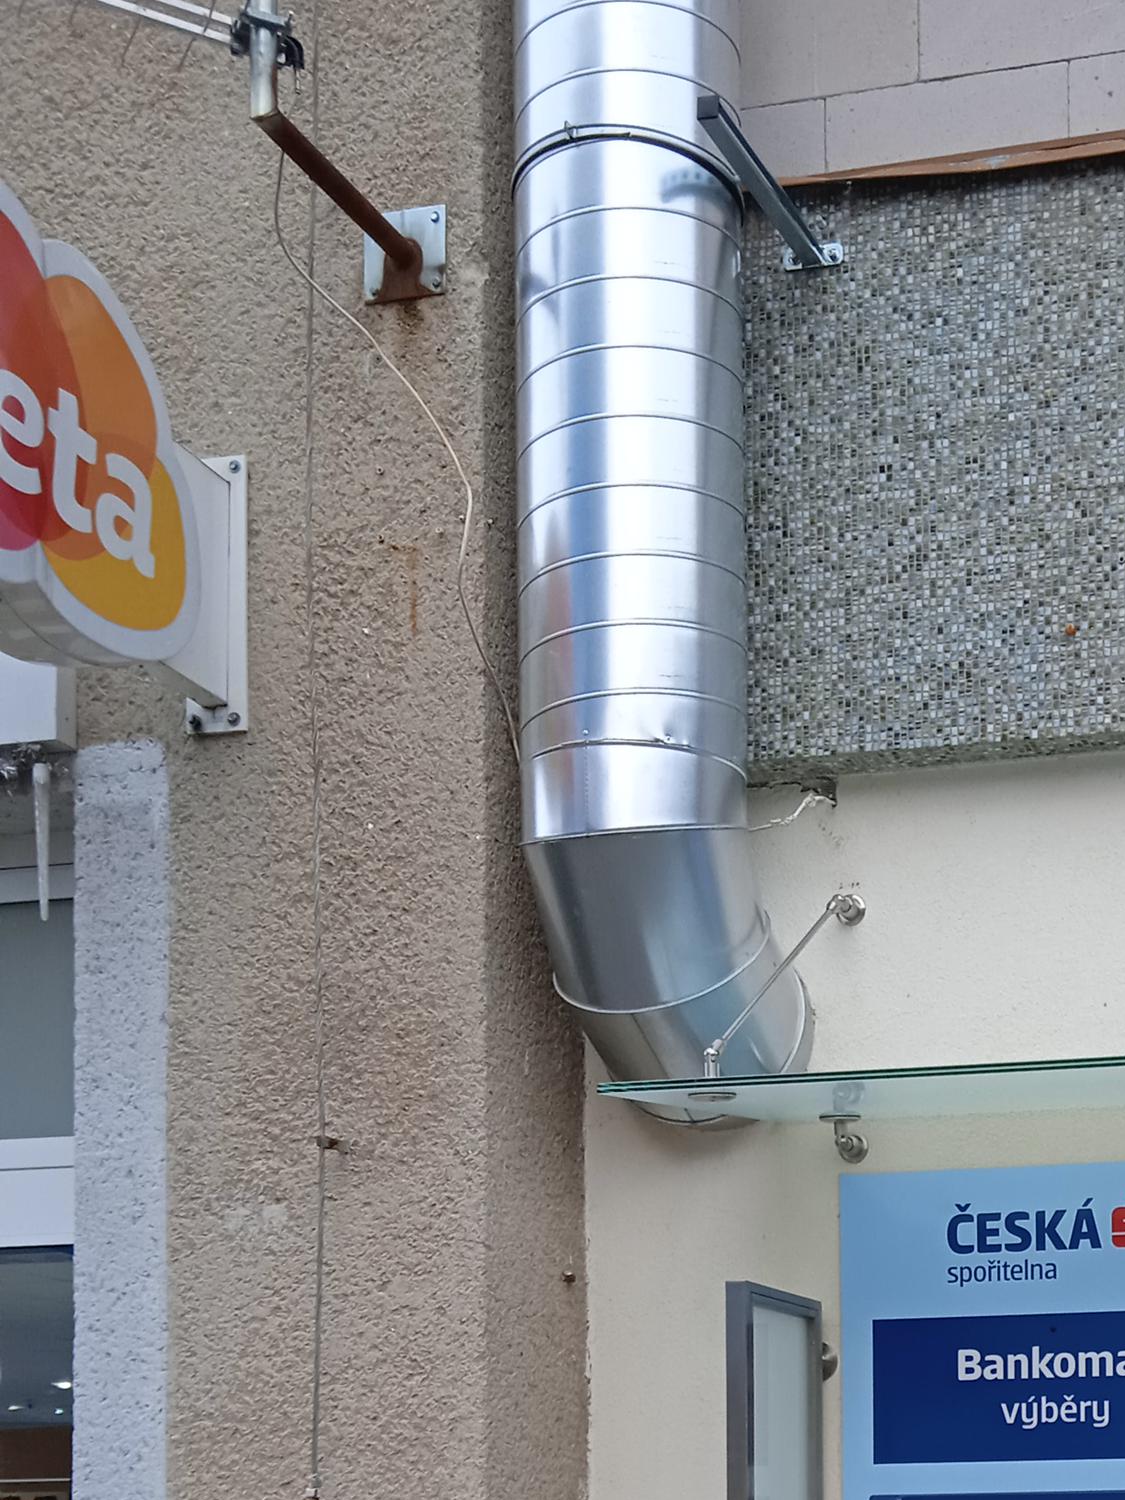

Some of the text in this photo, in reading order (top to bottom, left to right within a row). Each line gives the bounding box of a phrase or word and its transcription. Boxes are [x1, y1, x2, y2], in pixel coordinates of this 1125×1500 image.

[947, 1198, 1102, 1255] ČESKÁ
[947, 1259, 1058, 1287] spořitelna
[1001, 1394, 1110, 1429] výběry
